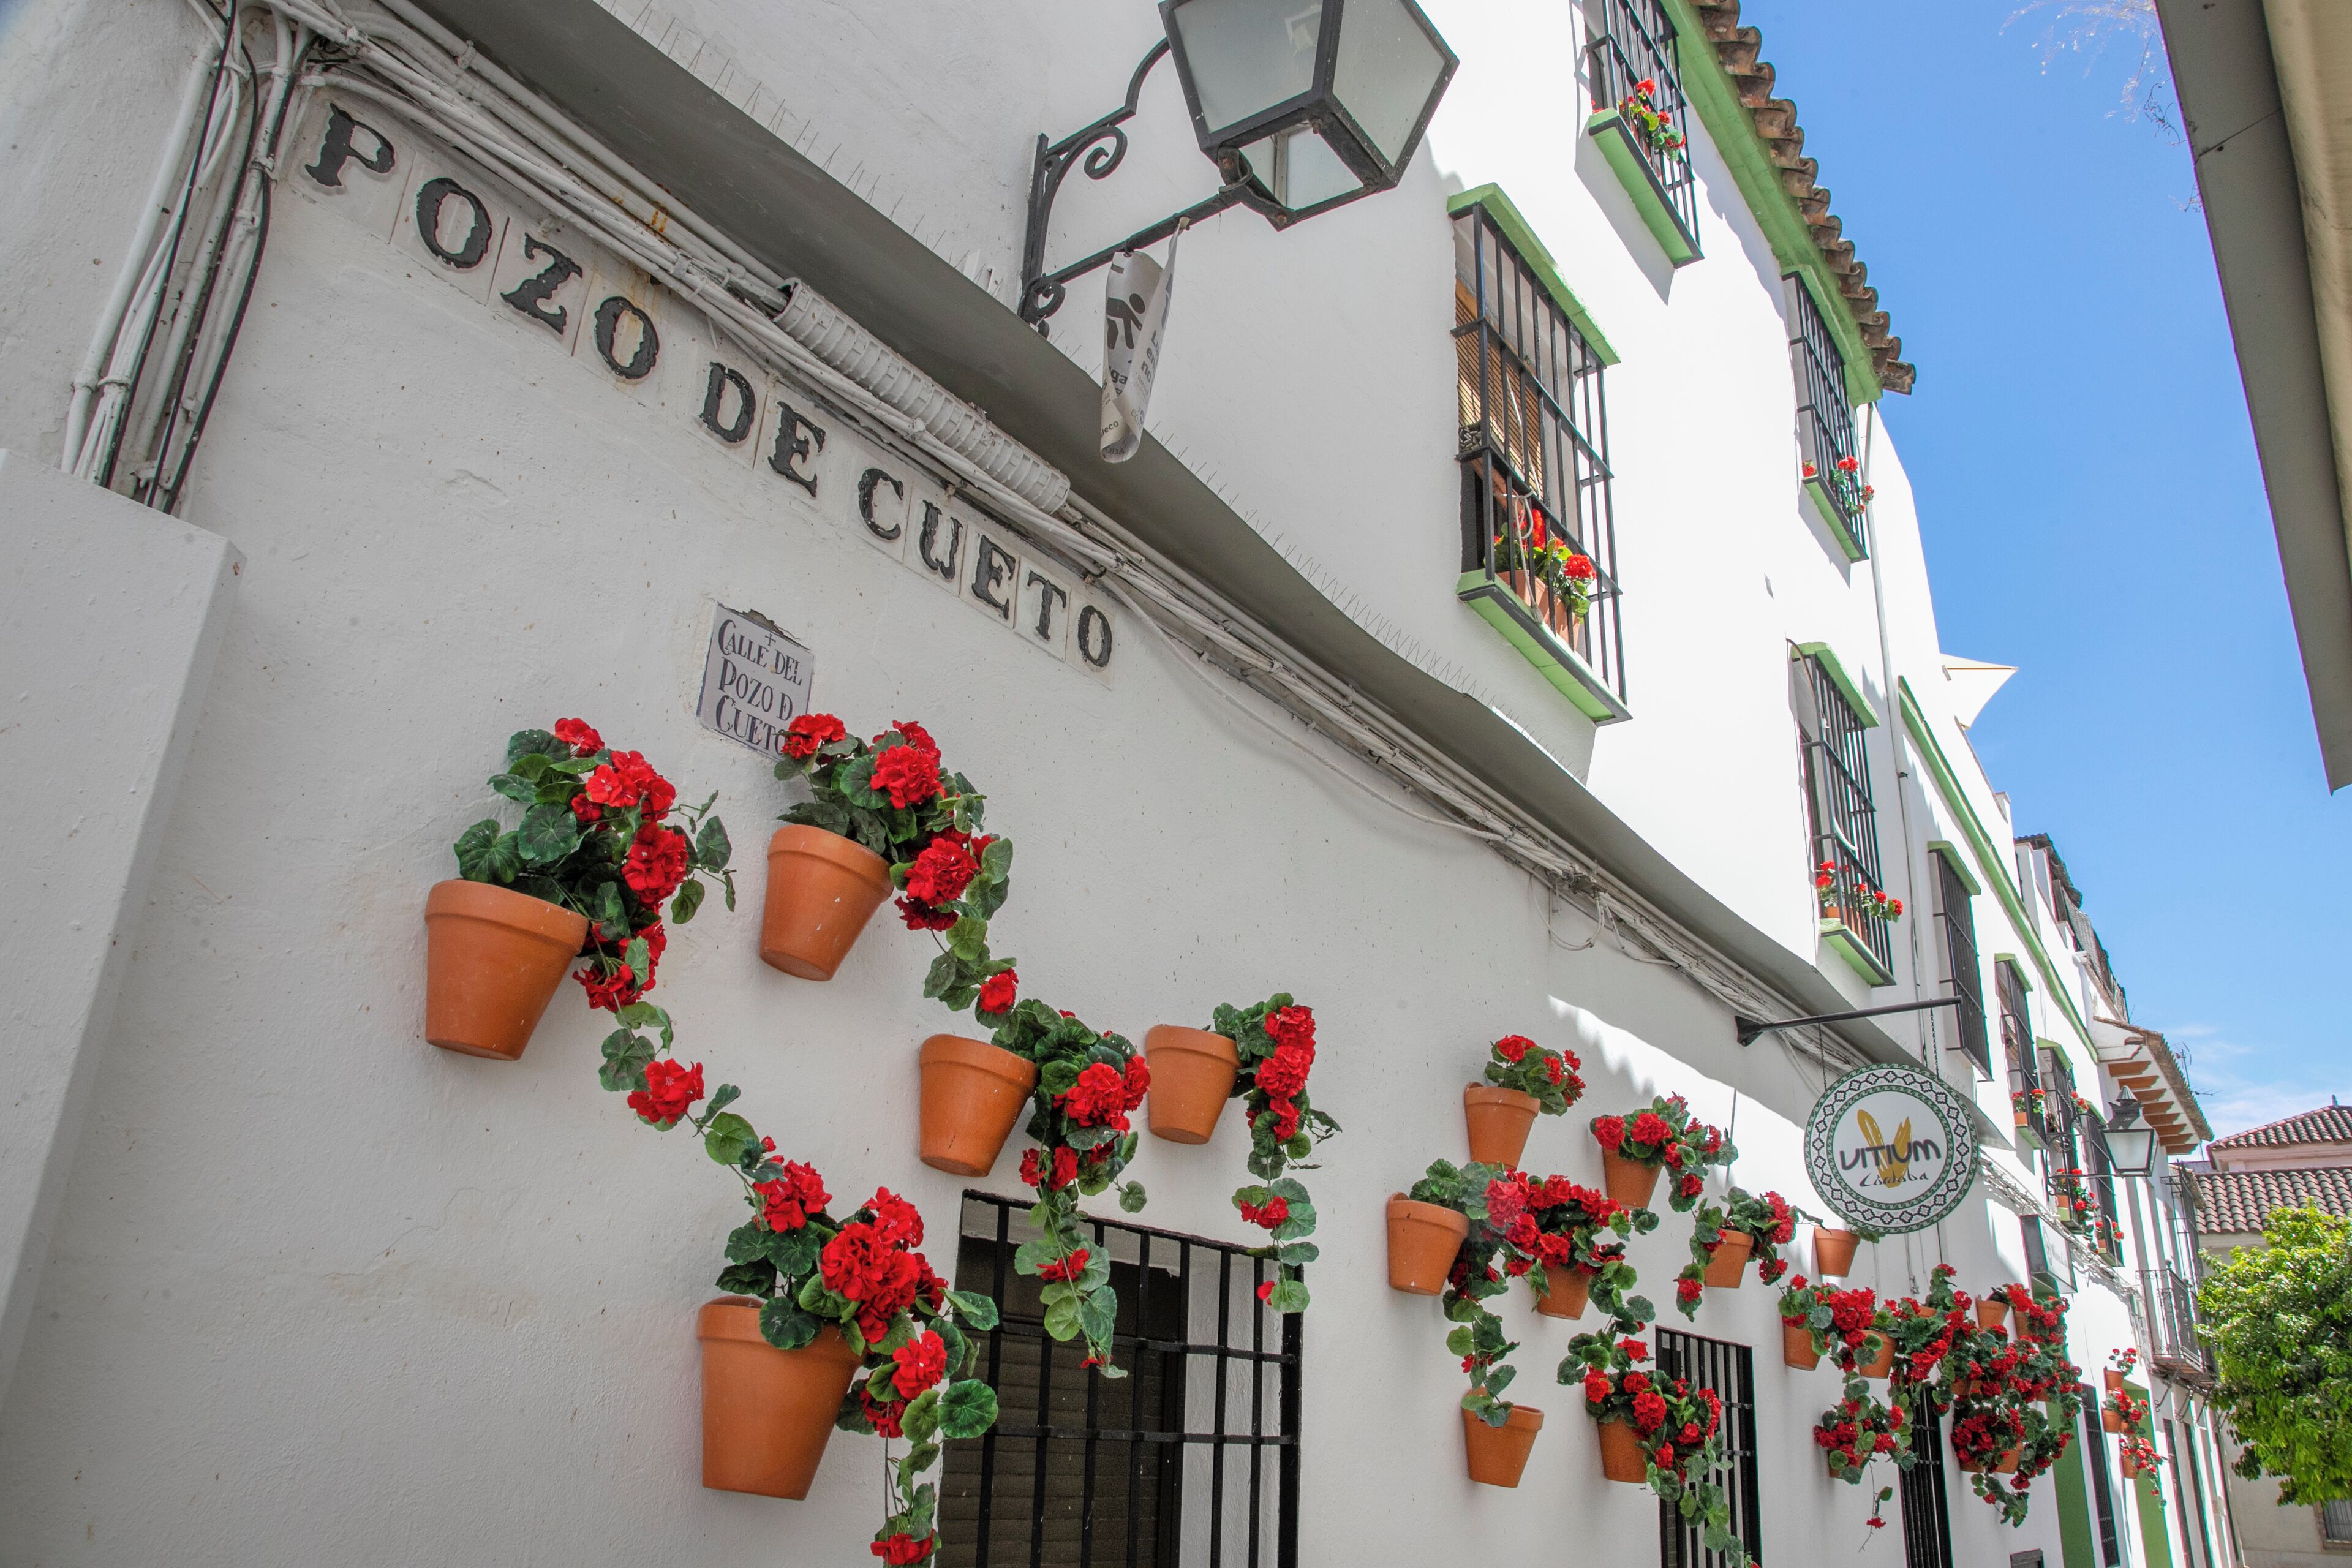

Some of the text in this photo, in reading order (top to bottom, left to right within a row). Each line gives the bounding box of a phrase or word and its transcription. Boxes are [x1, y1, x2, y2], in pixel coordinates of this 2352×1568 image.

[305, 102, 1112, 668] POZO DE CUETO
[717, 657, 773, 712] POZO
[718, 619, 802, 685] CALLE DEL
